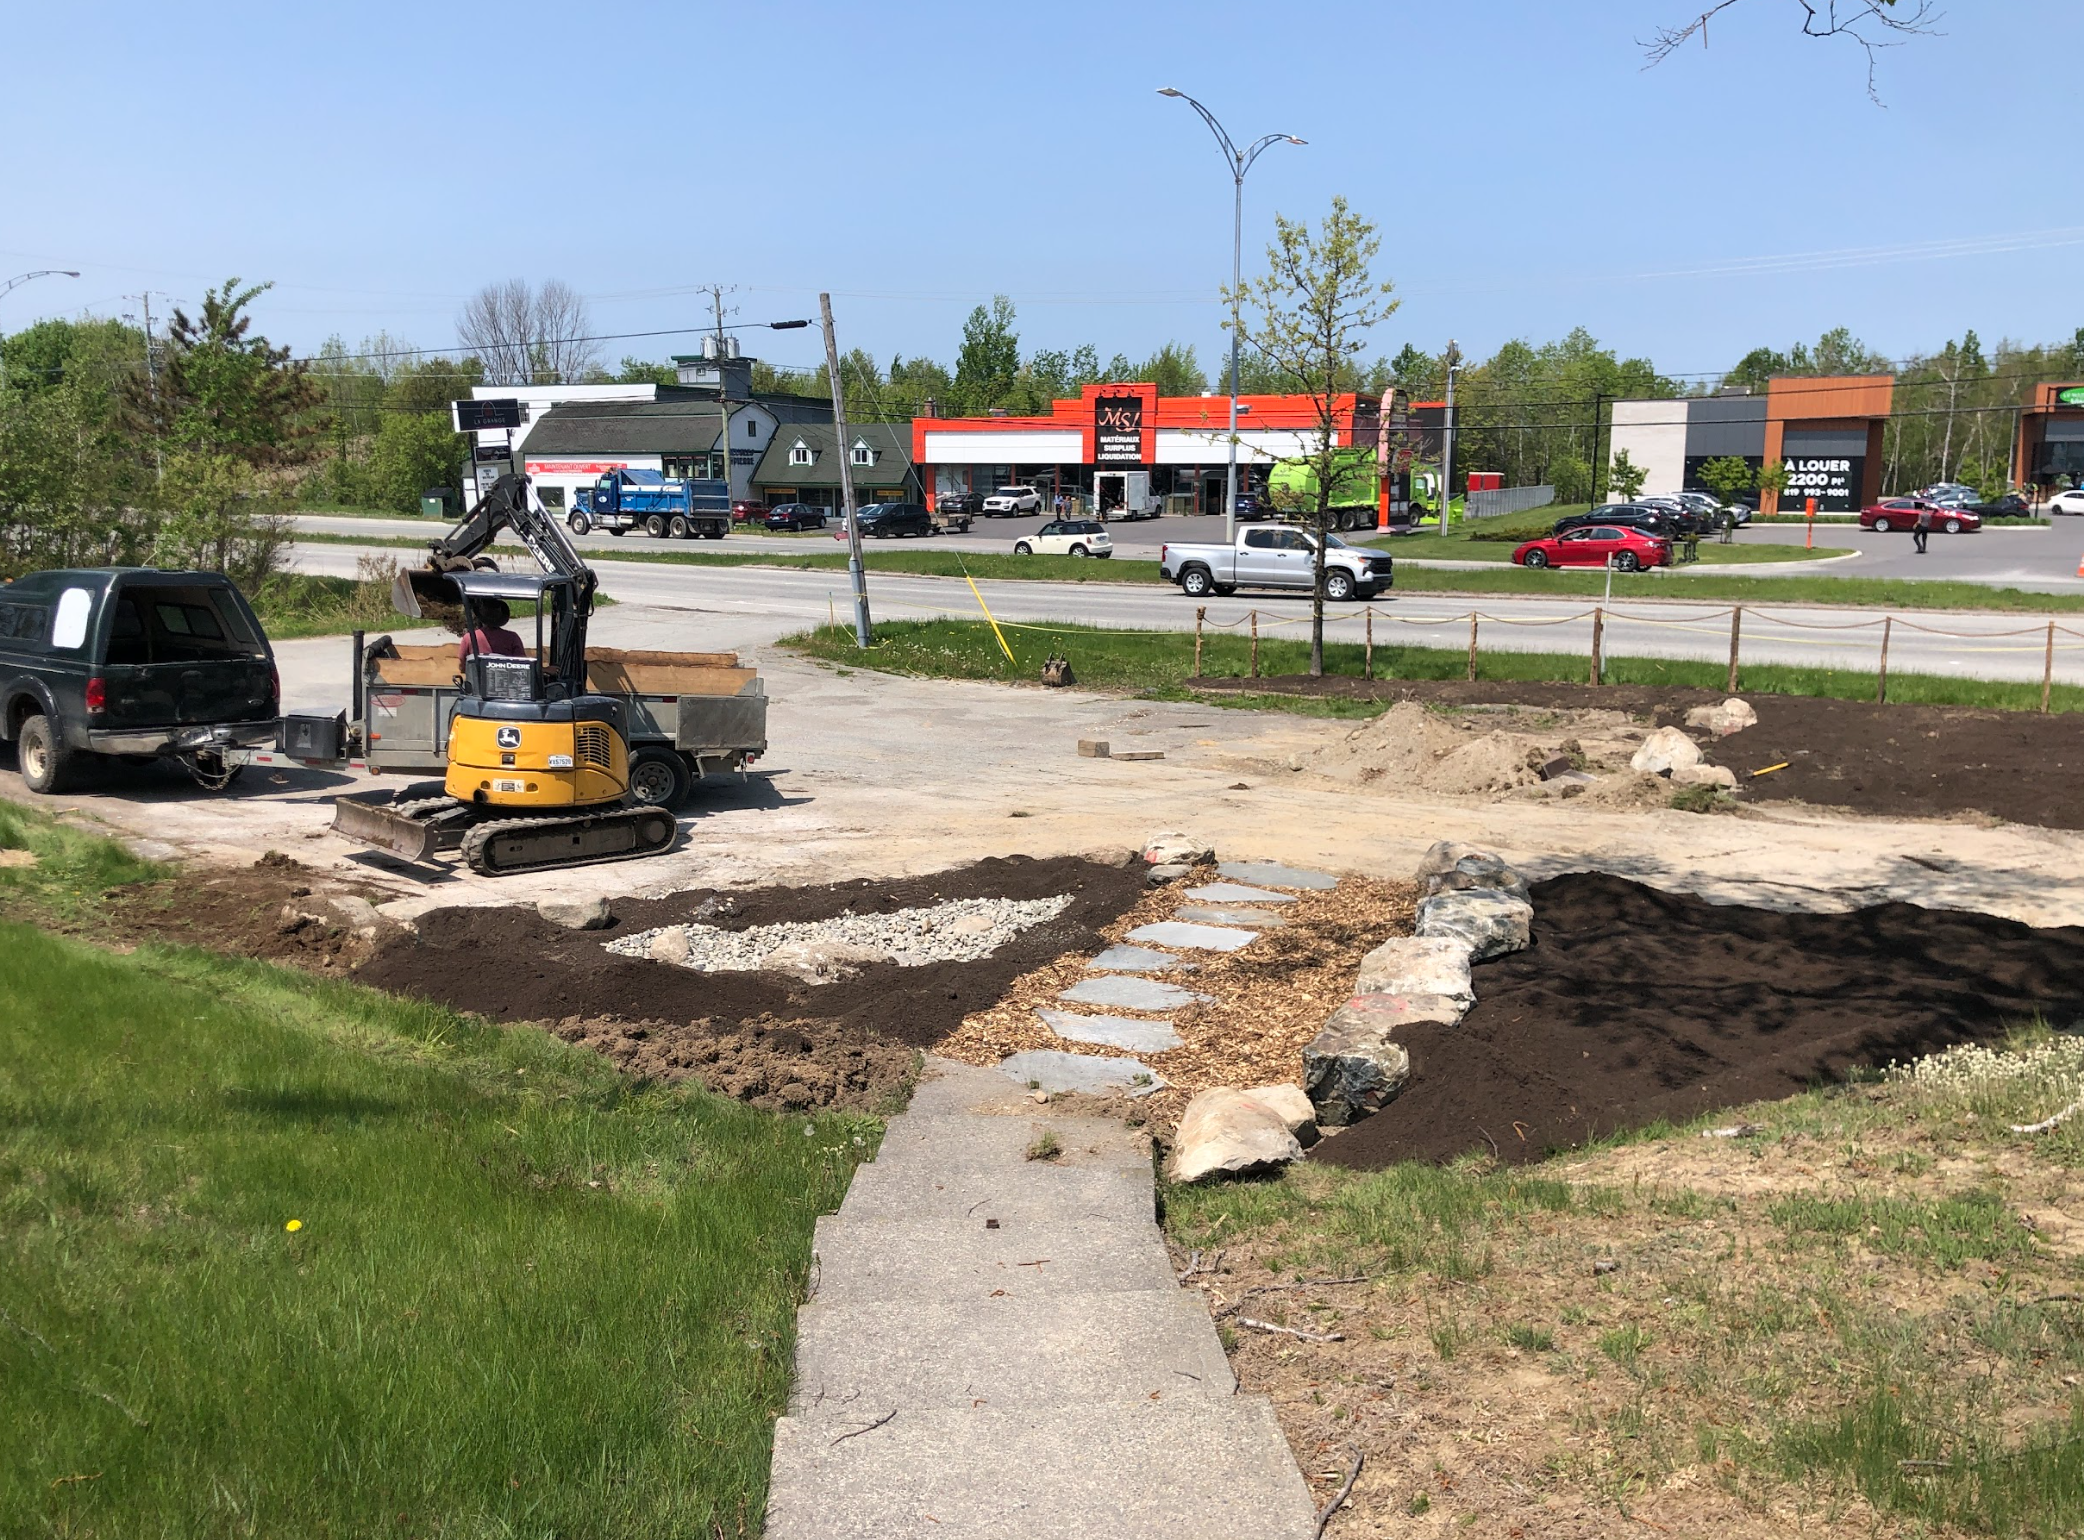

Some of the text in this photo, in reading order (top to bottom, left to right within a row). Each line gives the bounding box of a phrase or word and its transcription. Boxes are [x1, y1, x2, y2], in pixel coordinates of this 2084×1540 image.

[482, 417, 506, 425] GRANGE
[1100, 435, 1140, 443] MATÉRIAUX
[1784, 457, 1850, 471] À LOUER
[1787, 473, 1829, 486] 2200
[1783, 488, 1849, 497] 819 993-9001
